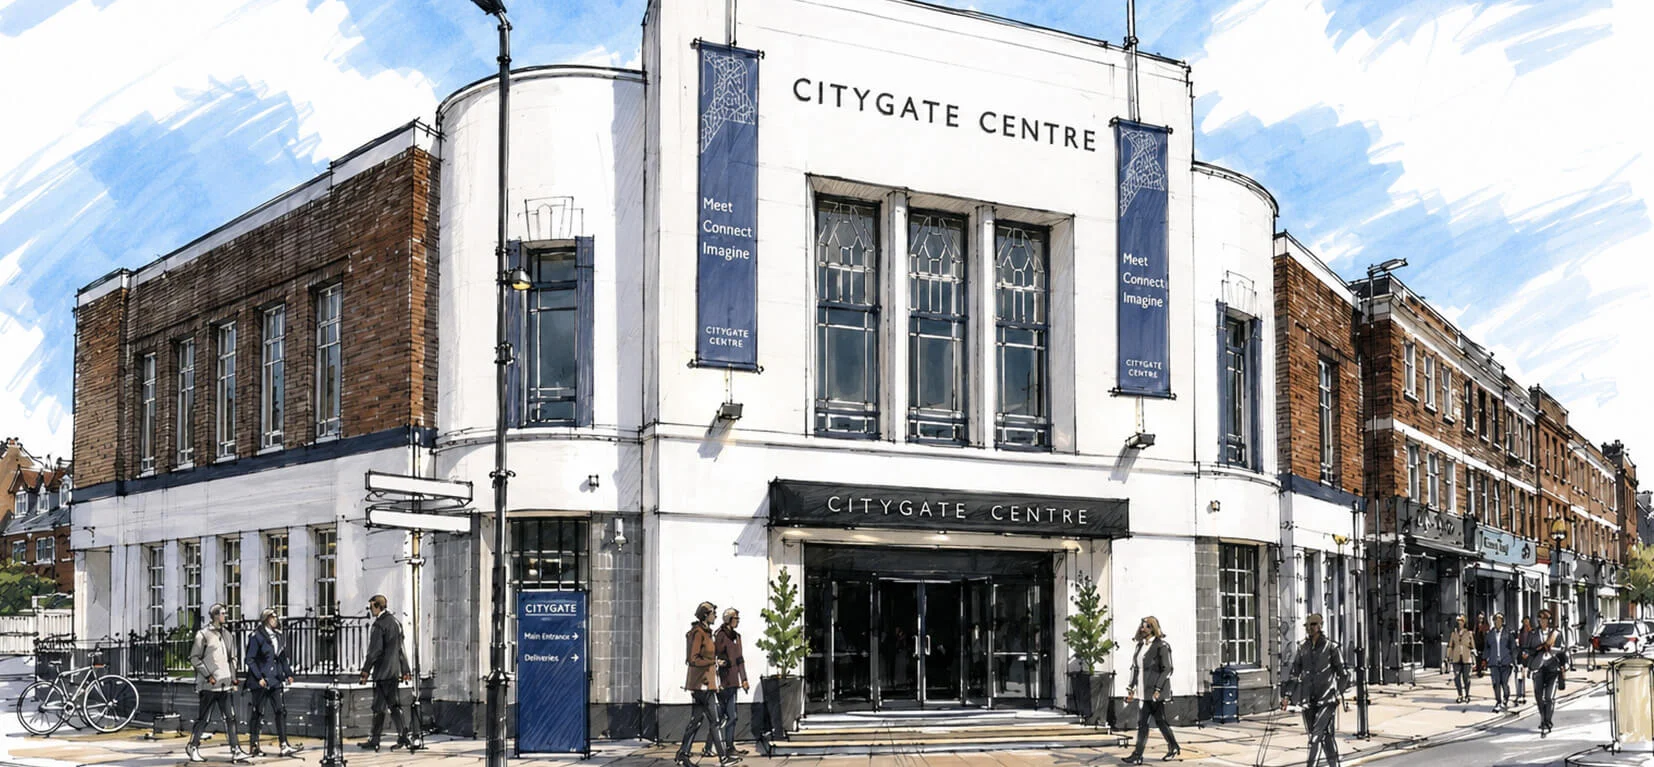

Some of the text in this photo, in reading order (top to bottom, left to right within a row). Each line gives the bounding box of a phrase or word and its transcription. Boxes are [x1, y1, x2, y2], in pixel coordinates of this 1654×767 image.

[793, 78, 1096, 152] CITYGATE CENTRE
[703, 197, 733, 212] Meet
[703, 219, 752, 238] Connect
[703, 241, 750, 261] Imagine
[1123, 252, 1148, 266] Meet
[1123, 272, 1164, 288] Connect
[1123, 292, 1163, 309] Imagine
[705, 326, 749, 338] CITYGATE
[709, 337, 744, 348] CENTRE
[827, 496, 1088, 525] CITYGATE CENTRE
[525, 603, 577, 613] CITYGATE
[524, 632, 571, 640] Main Entrance
[524, 653, 559, 662] Deliveries
